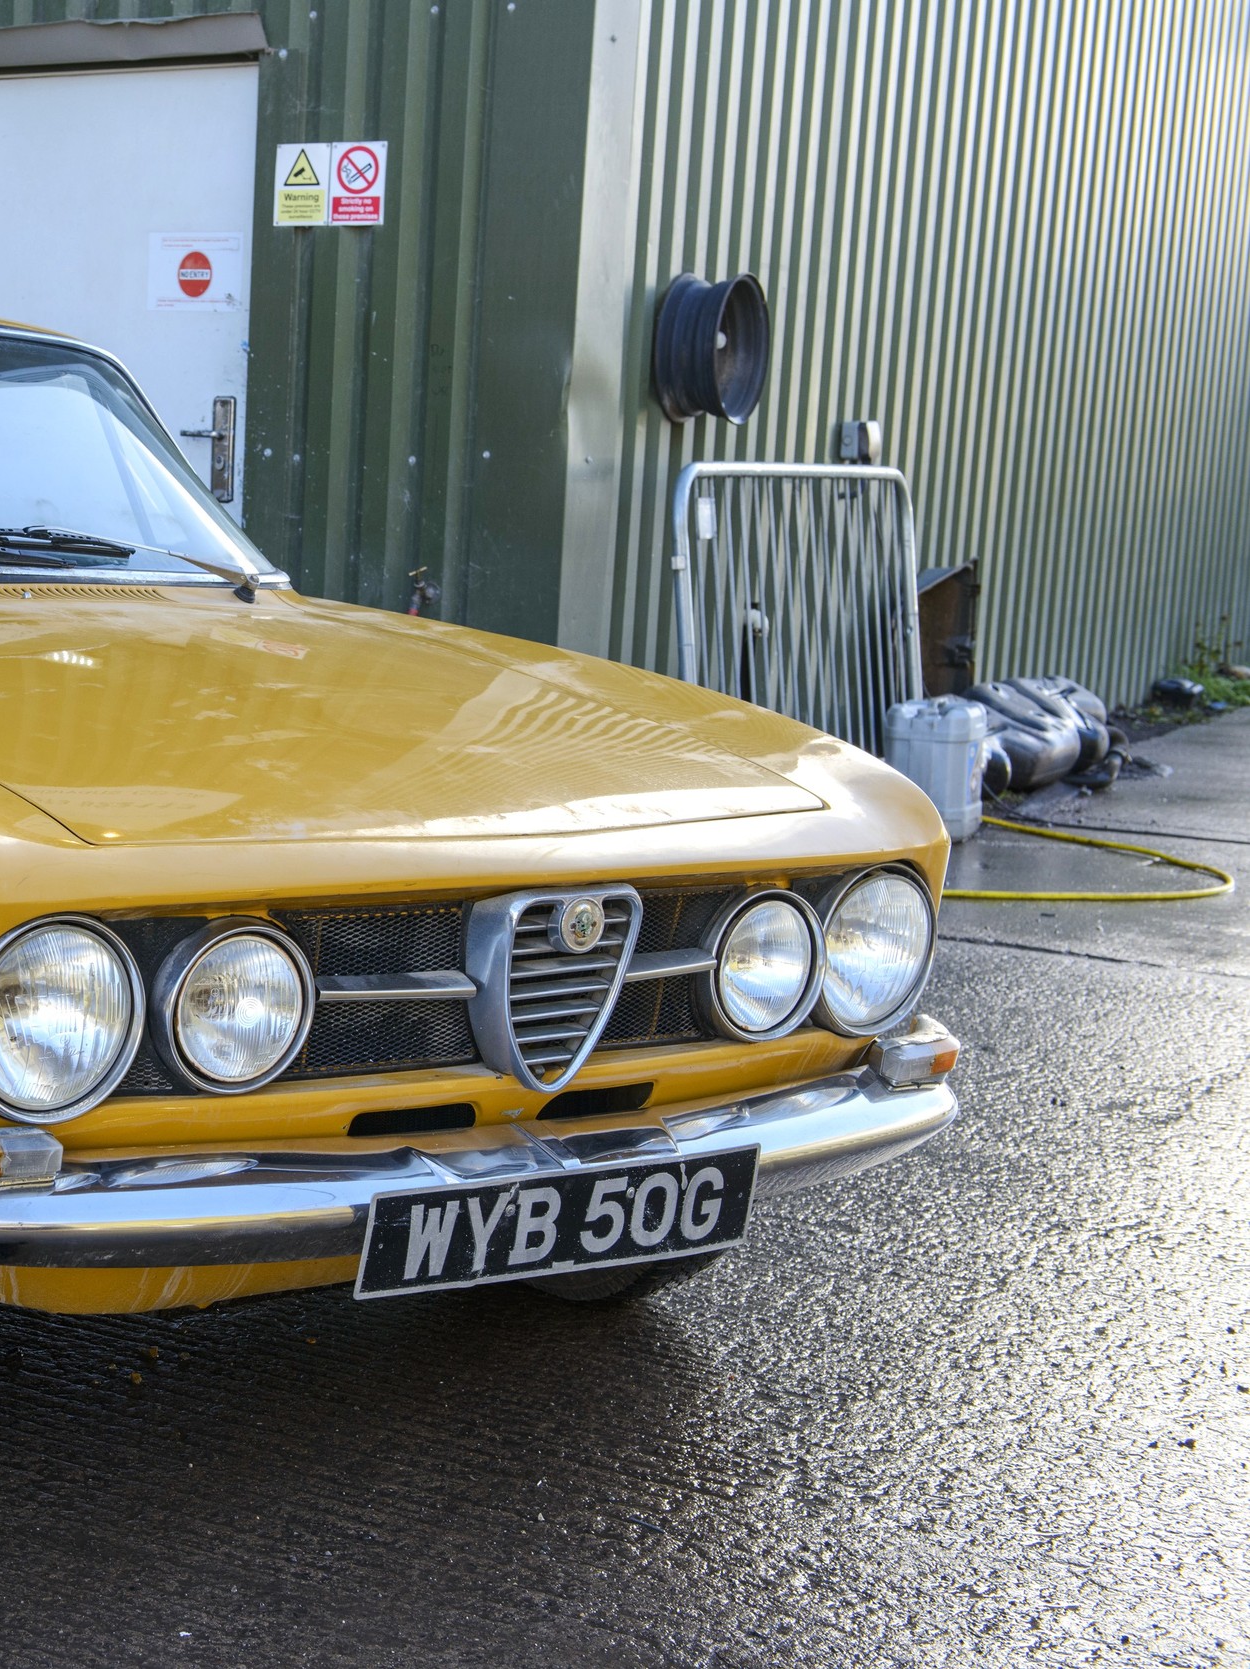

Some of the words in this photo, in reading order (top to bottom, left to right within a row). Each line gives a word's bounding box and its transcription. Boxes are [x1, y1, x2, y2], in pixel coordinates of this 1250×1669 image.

[284, 193, 320, 203] Warning
[338, 205, 364, 213] smoking
[403, 1186, 562, 1280] WYB
[579, 1166, 725, 1254] 50G
